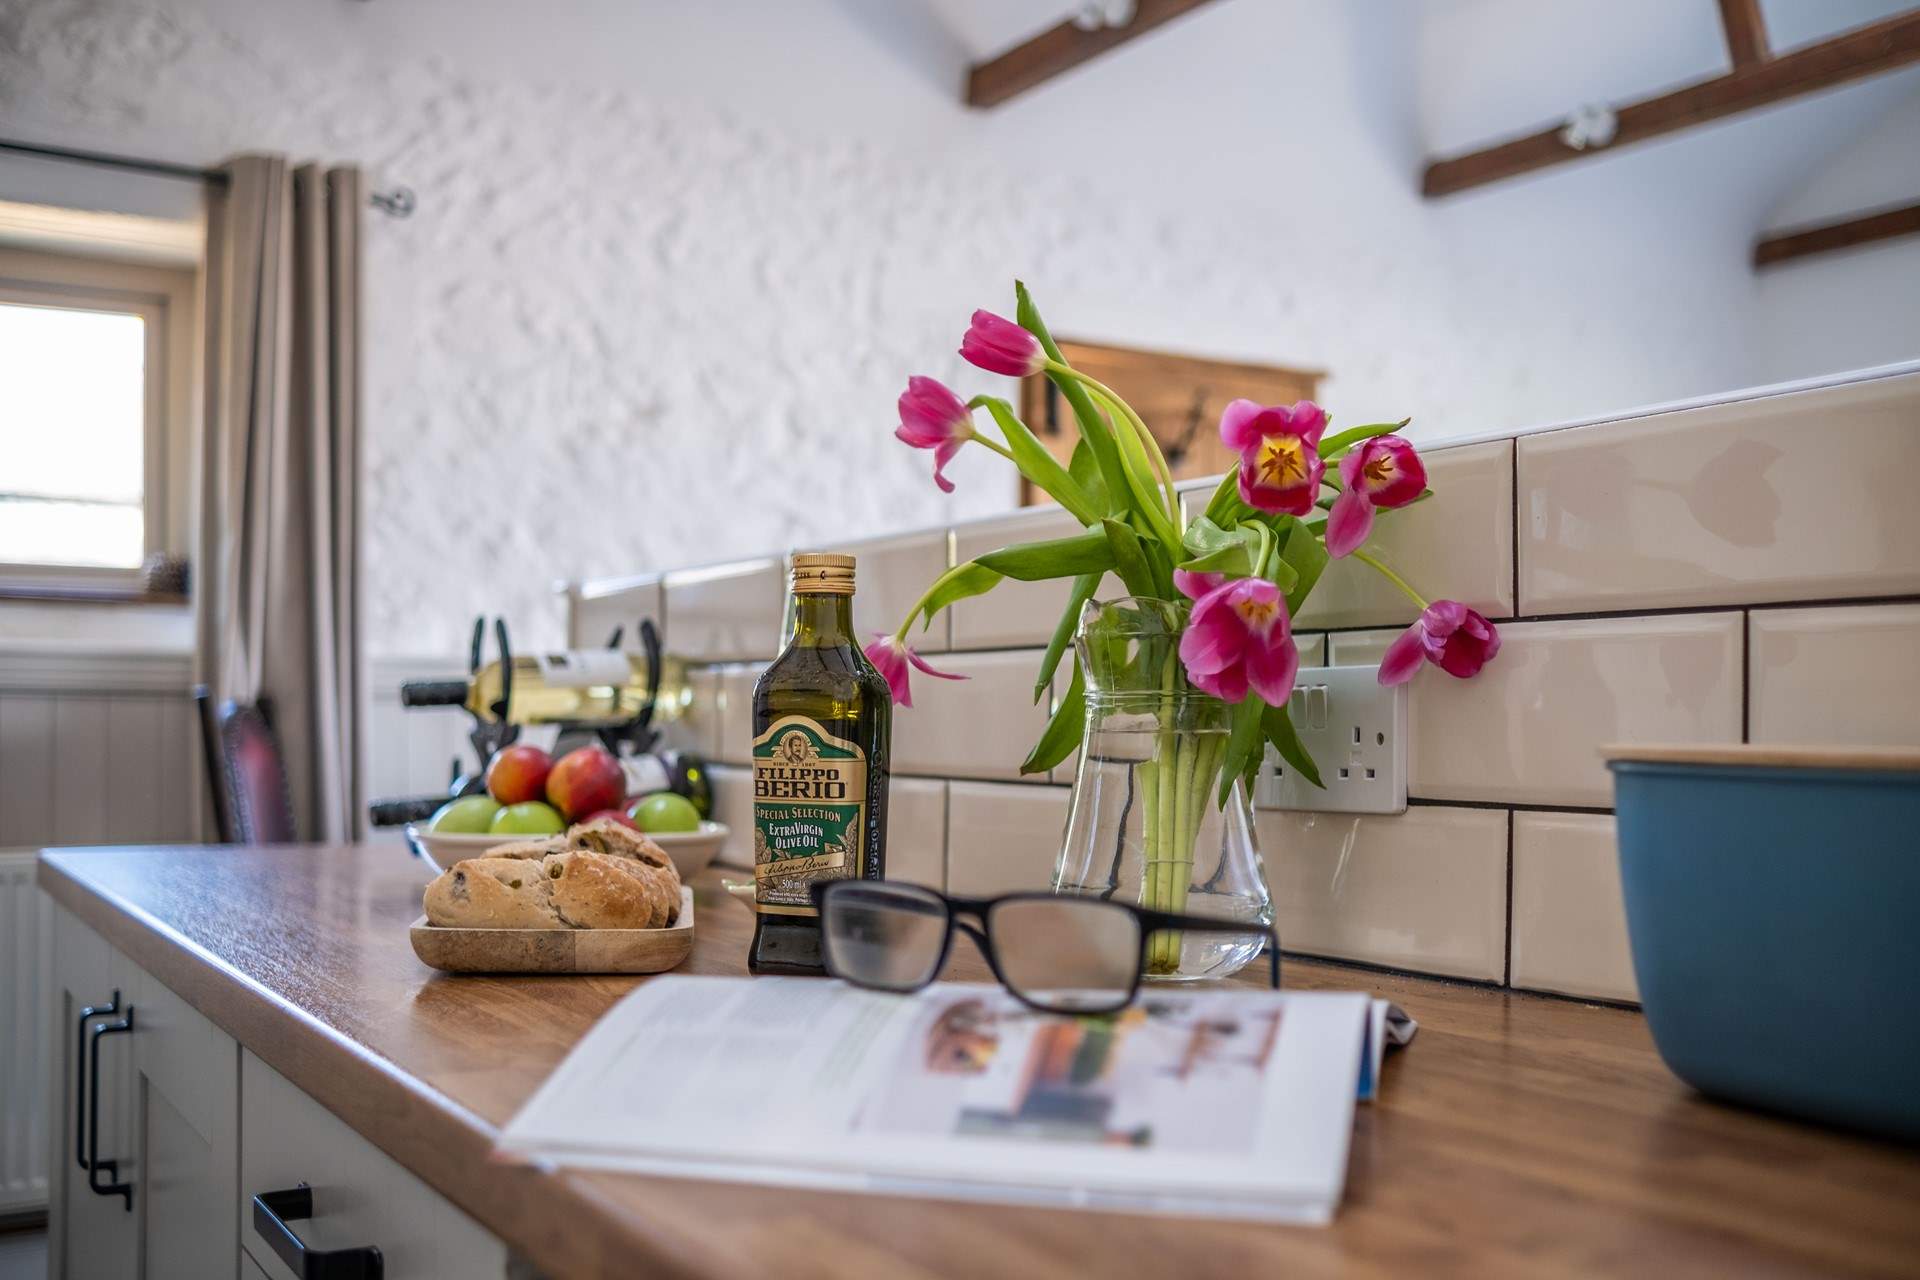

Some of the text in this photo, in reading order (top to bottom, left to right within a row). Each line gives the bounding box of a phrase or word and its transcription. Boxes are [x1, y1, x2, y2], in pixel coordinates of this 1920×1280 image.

[758, 767, 839, 780] FILIPPO
[755, 780, 845, 799] BERIO
[756, 806, 840, 822] SPECIAL SELECTION
[776, 835, 819, 849] OLIVE OIL
[782, 880, 793, 889] 500
